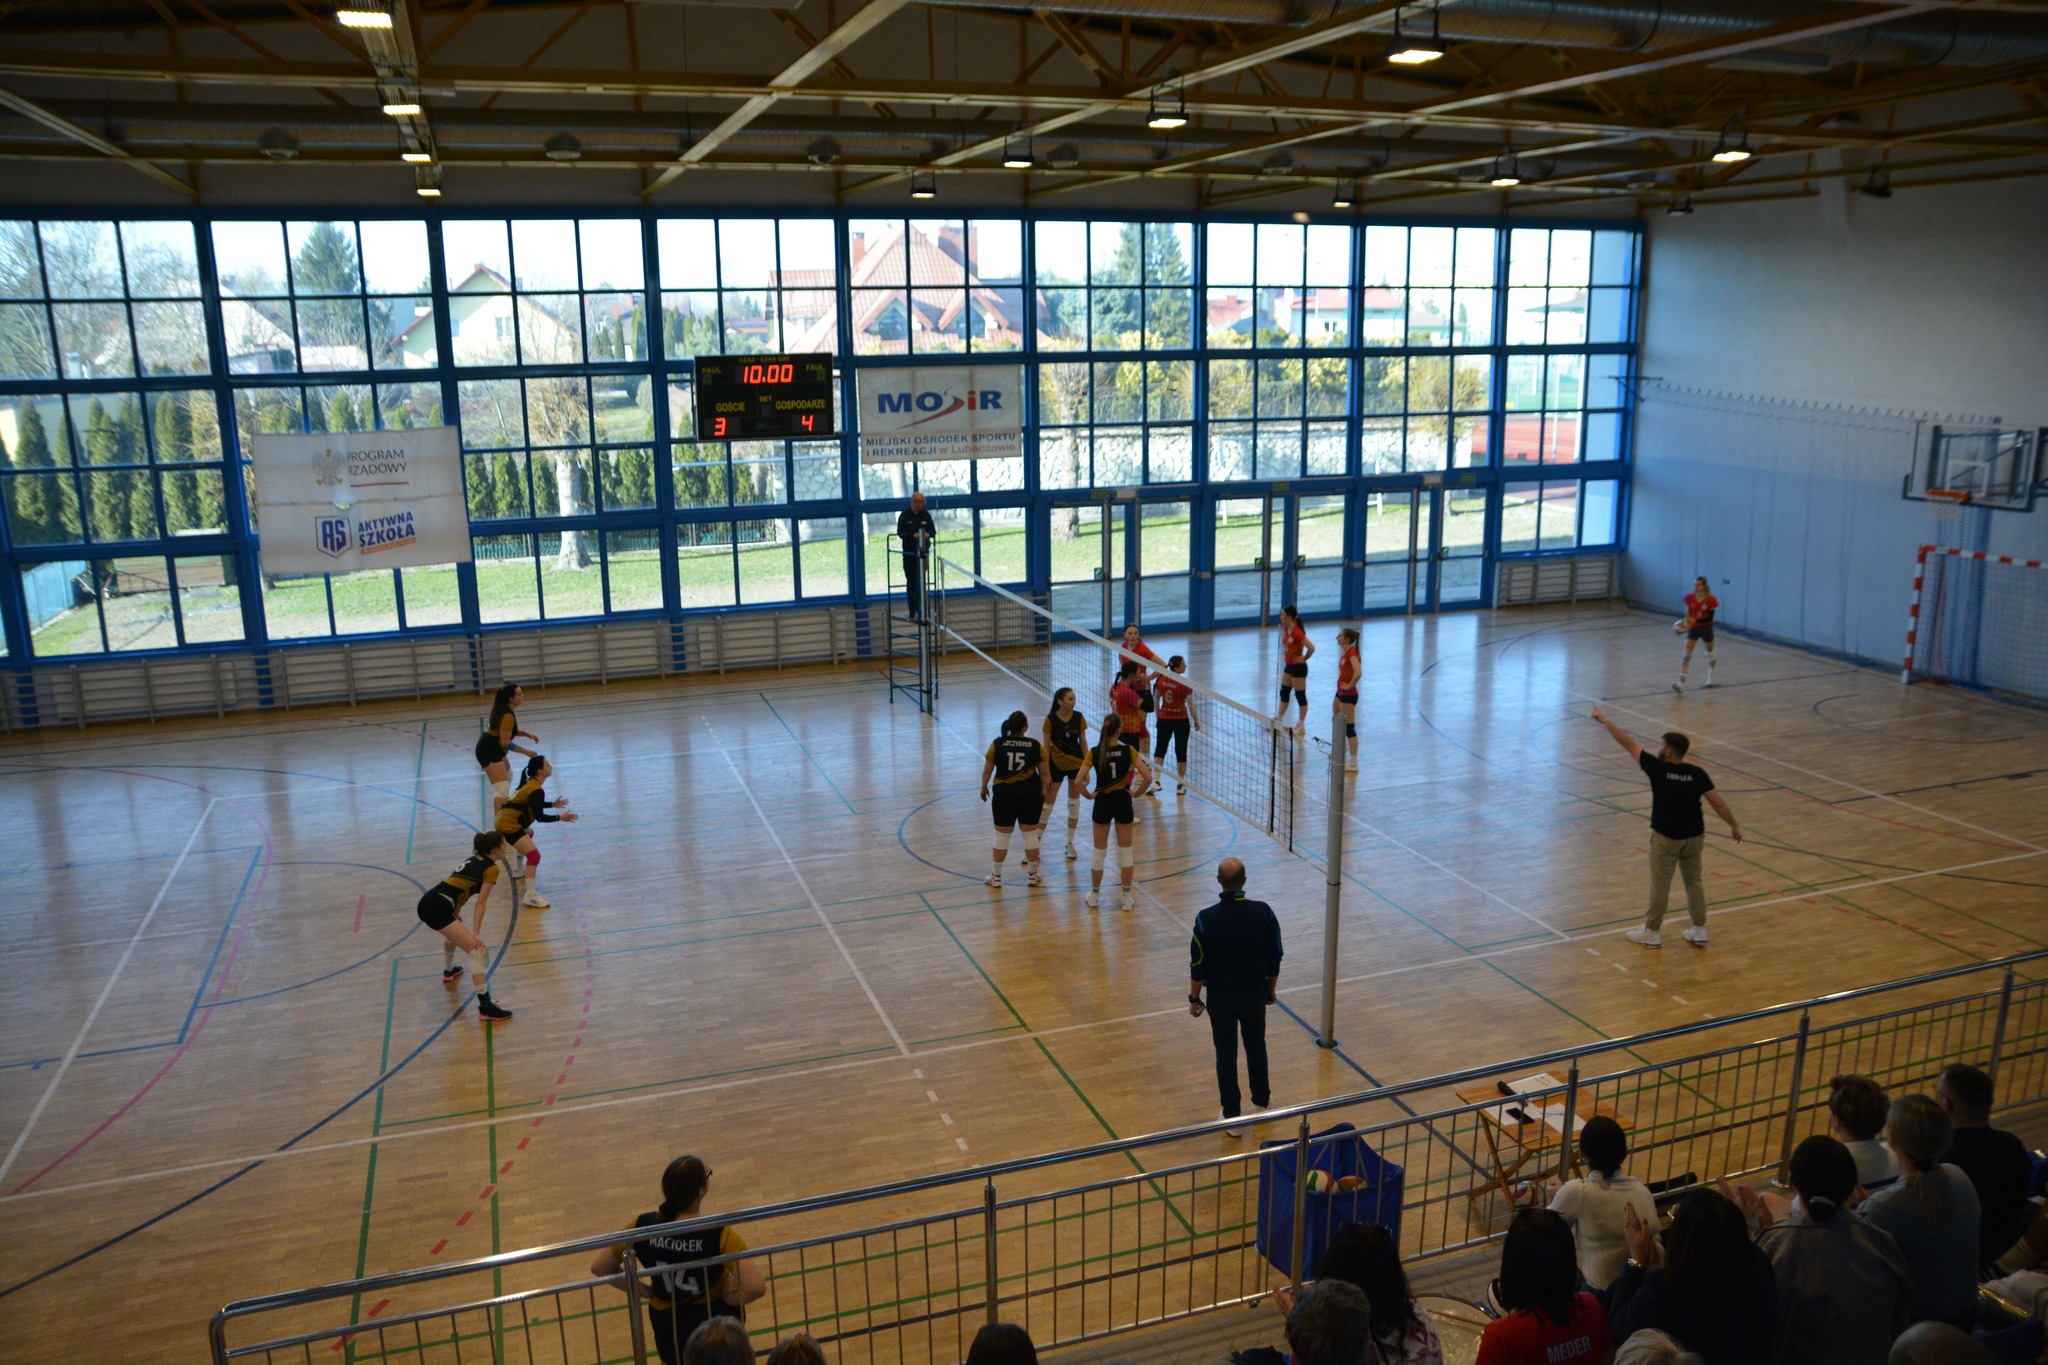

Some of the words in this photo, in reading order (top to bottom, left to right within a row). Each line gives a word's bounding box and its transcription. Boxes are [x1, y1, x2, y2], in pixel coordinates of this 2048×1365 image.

[743, 364, 793, 384] 10.00
[716, 401, 746, 412] GOŚCIE
[775, 400, 826, 410] GOSPODARZE
[713, 417, 727, 436] 3
[801, 414, 814, 432] 4
[866, 437, 911, 446] MIEJSKI
[914, 434, 968, 444] OŚRODEK
[971, 432, 1016, 442] SPORTU
[347, 449, 404, 461] PROGRAM
[872, 446, 936, 456] REKREACJI
[951, 443, 1015, 454] Lubaczowie
[348, 463, 406, 476] RZĄDOWY
[358, 511, 414, 533] AKTYWNA
[321, 519, 346, 552] AS
[359, 523, 416, 548] SZKOŁA
[1007, 752, 1026, 771] 15
[1109, 762, 1117, 779] 1
[649, 1236, 704, 1252] MACIOŁEK
[656, 1261, 700, 1296] 14
[1546, 1335, 1592, 1364] MEDER
